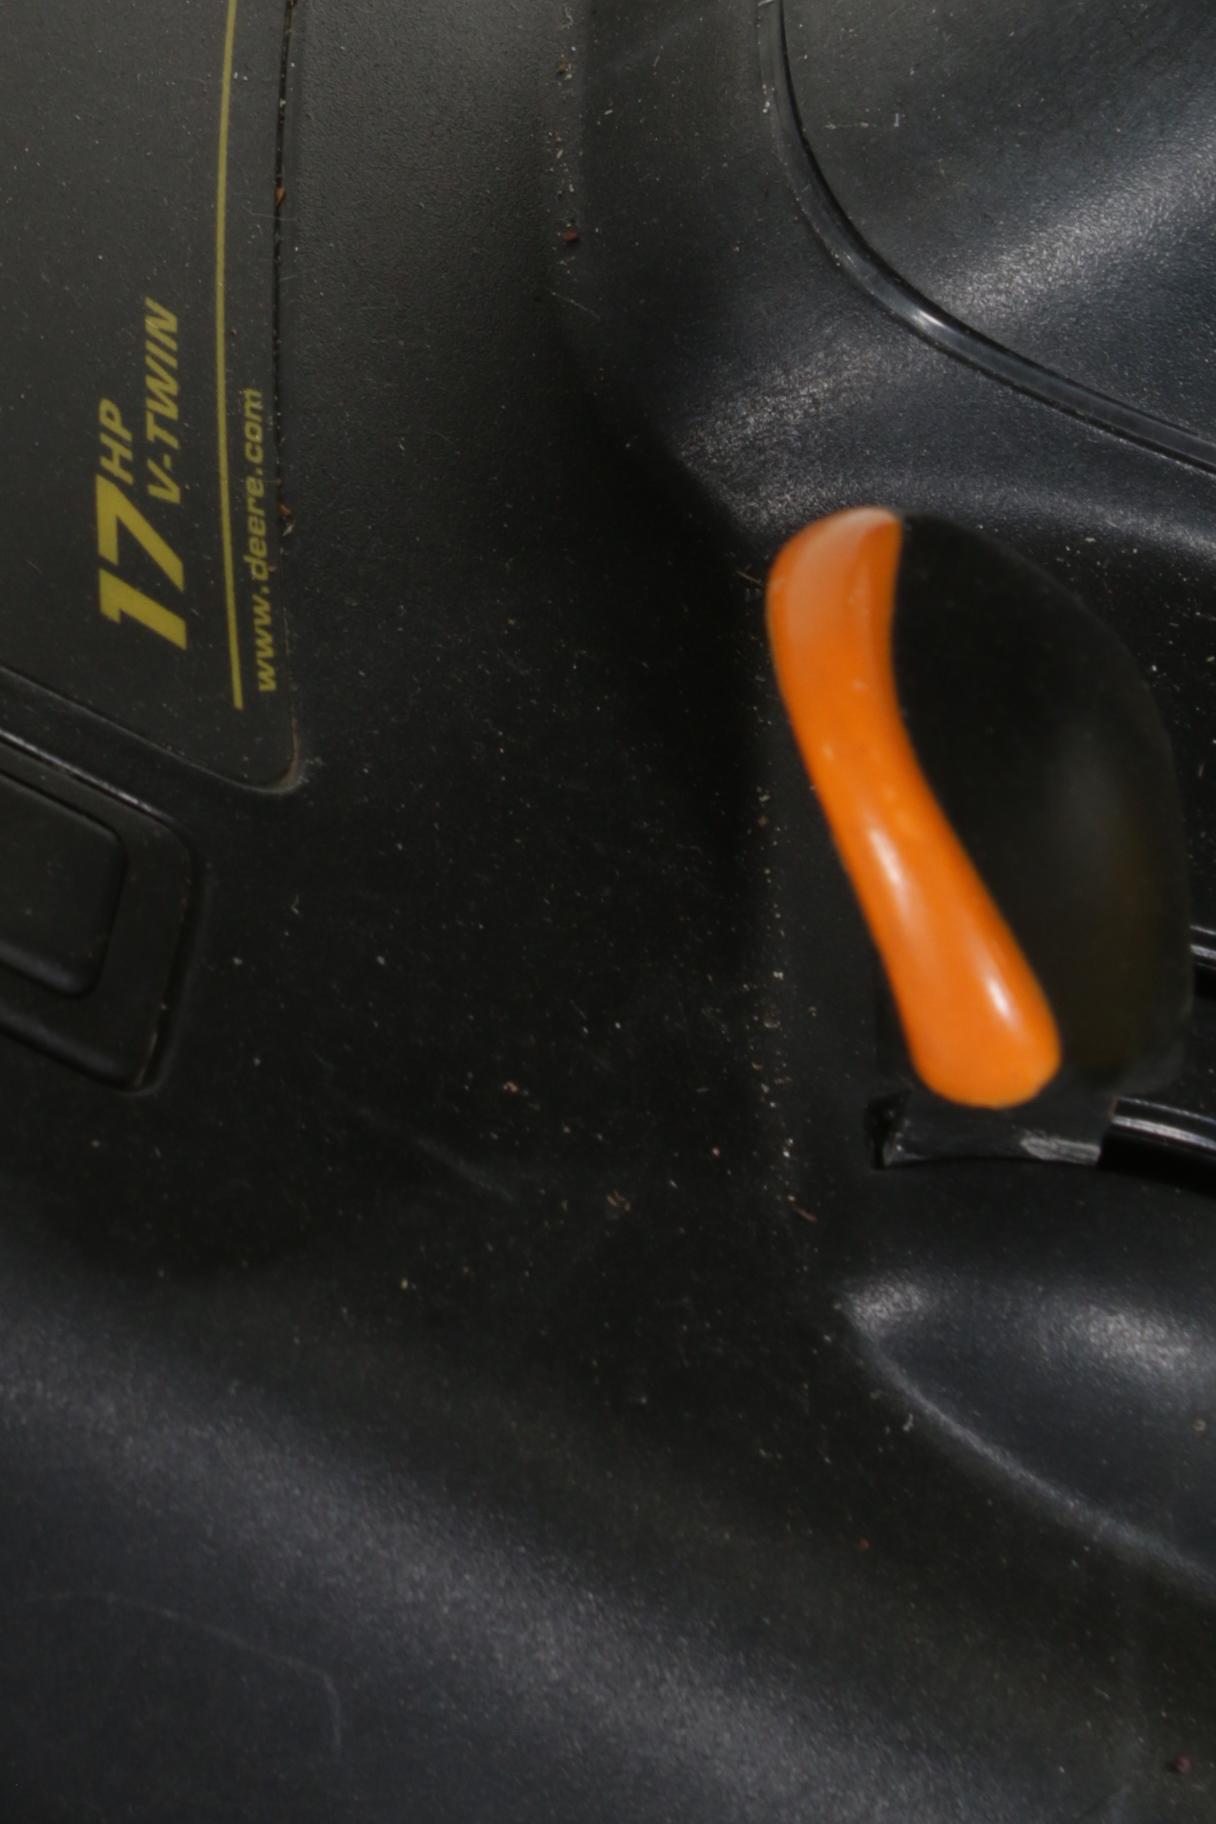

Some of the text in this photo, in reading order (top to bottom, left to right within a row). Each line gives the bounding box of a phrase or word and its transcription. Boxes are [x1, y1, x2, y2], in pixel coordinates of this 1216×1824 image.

[95, 397, 188, 652] 17 HP
[144, 296, 182, 505] V-TWIN
[242, 386, 277, 693] www.deere.com
